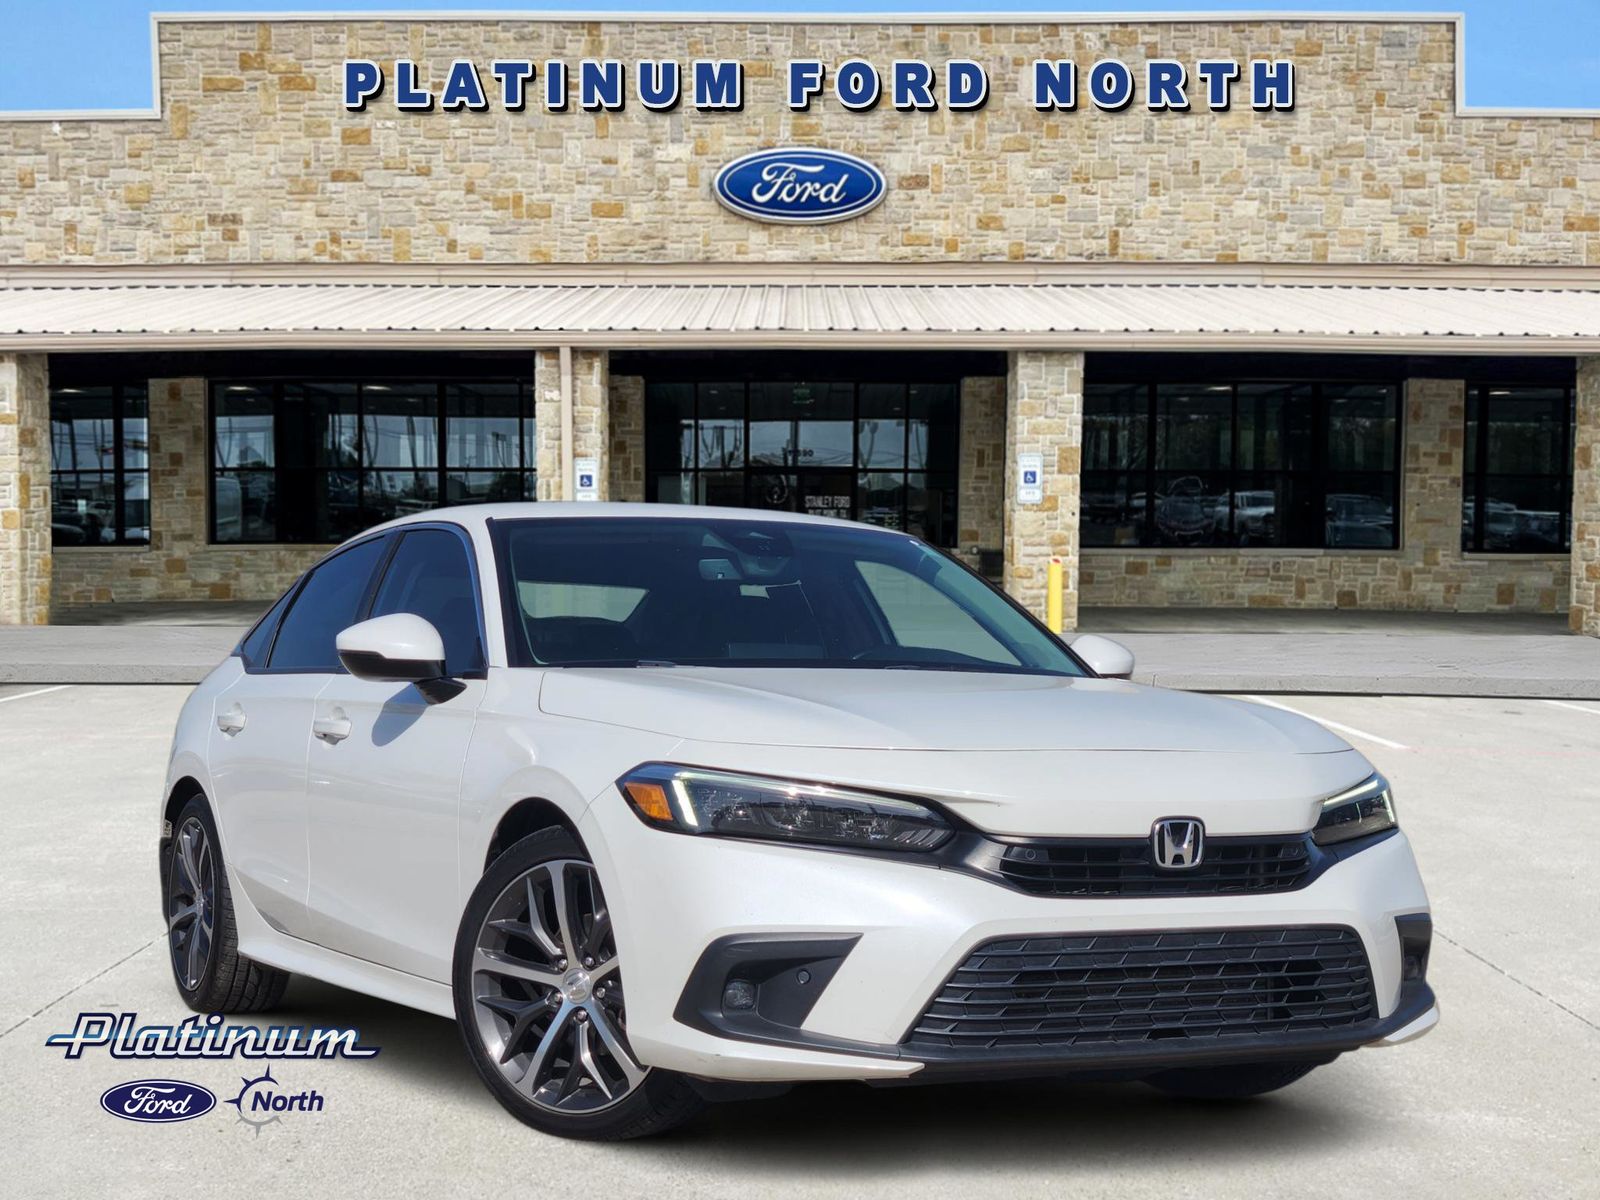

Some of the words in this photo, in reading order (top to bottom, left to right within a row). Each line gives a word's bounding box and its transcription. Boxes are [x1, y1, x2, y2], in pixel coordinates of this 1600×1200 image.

[342, 58, 744, 112] PLATINUM
[786, 58, 989, 112] FORD
[1033, 58, 1295, 112] NORTH
[750, 161, 848, 204] Ford
